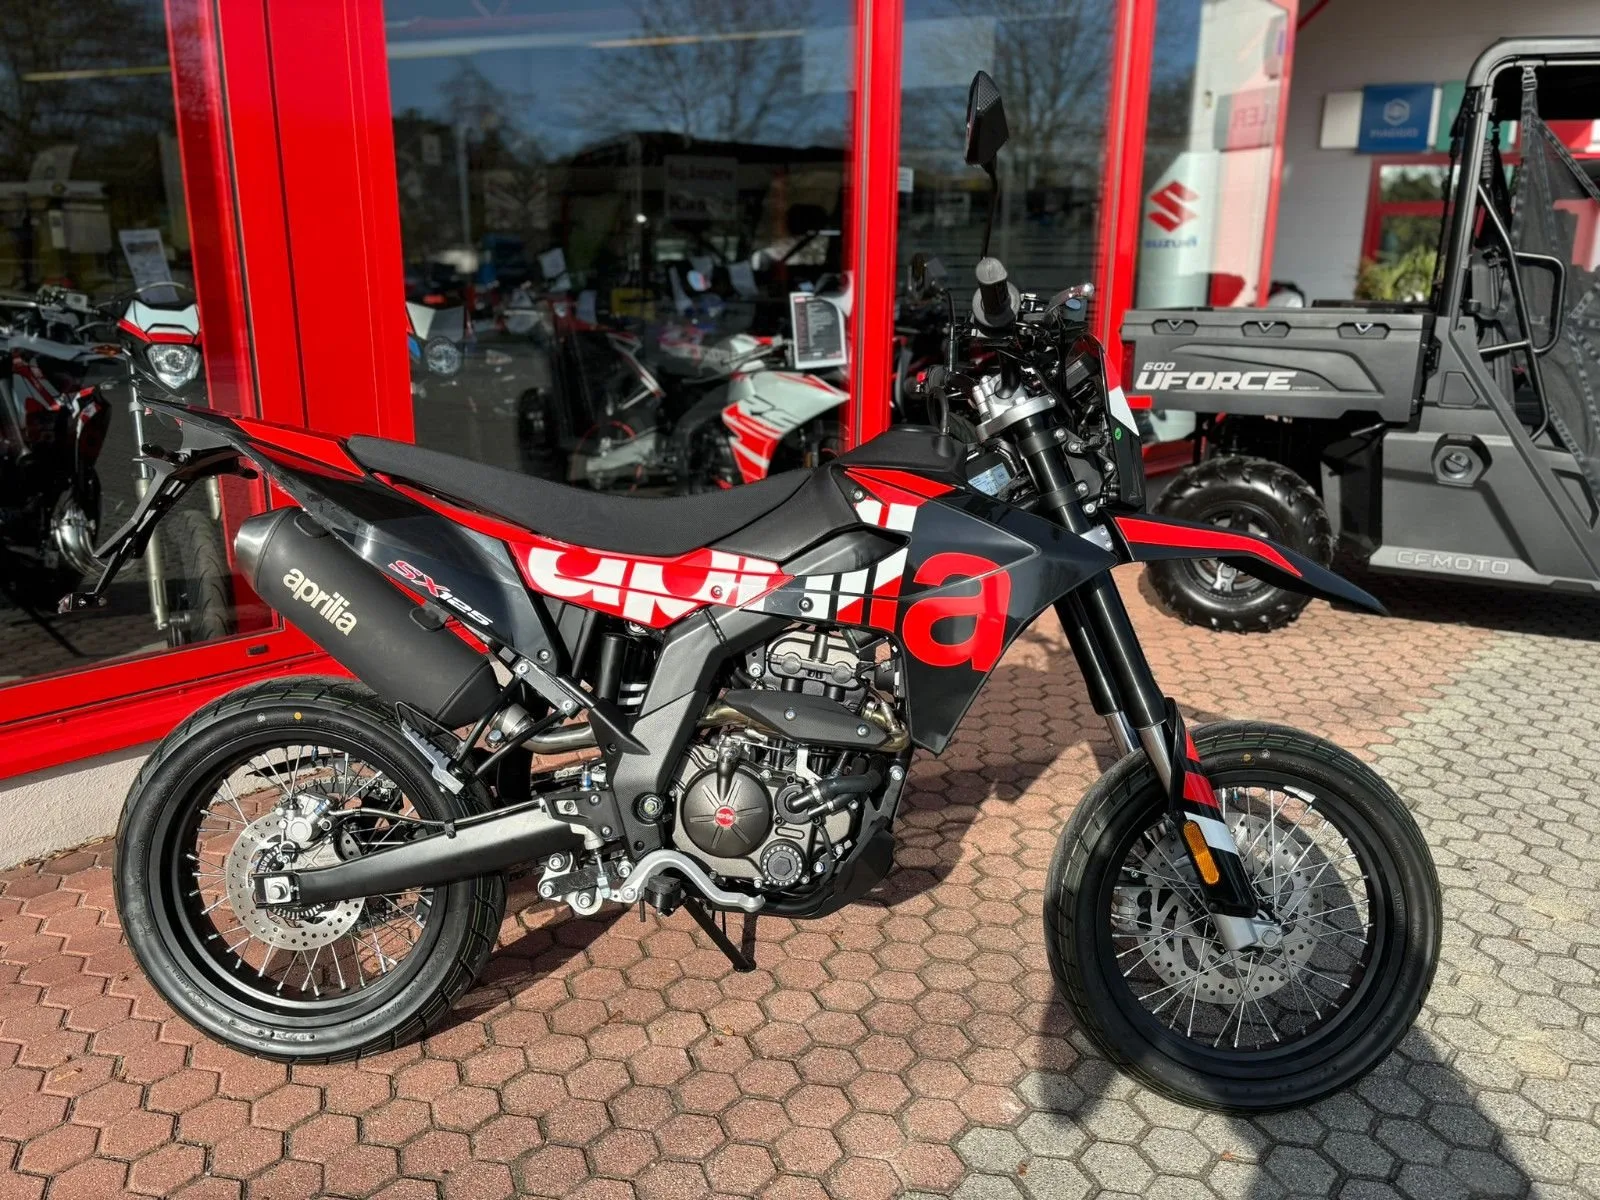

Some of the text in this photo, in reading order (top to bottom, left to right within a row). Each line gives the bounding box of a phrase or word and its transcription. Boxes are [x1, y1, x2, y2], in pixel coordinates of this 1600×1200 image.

[1142, 361, 1176, 371] 600
[1135, 371, 1298, 391] UFORCE
[1397, 550, 1510, 576] CFMOTO
[282, 567, 358, 637] aprilia
